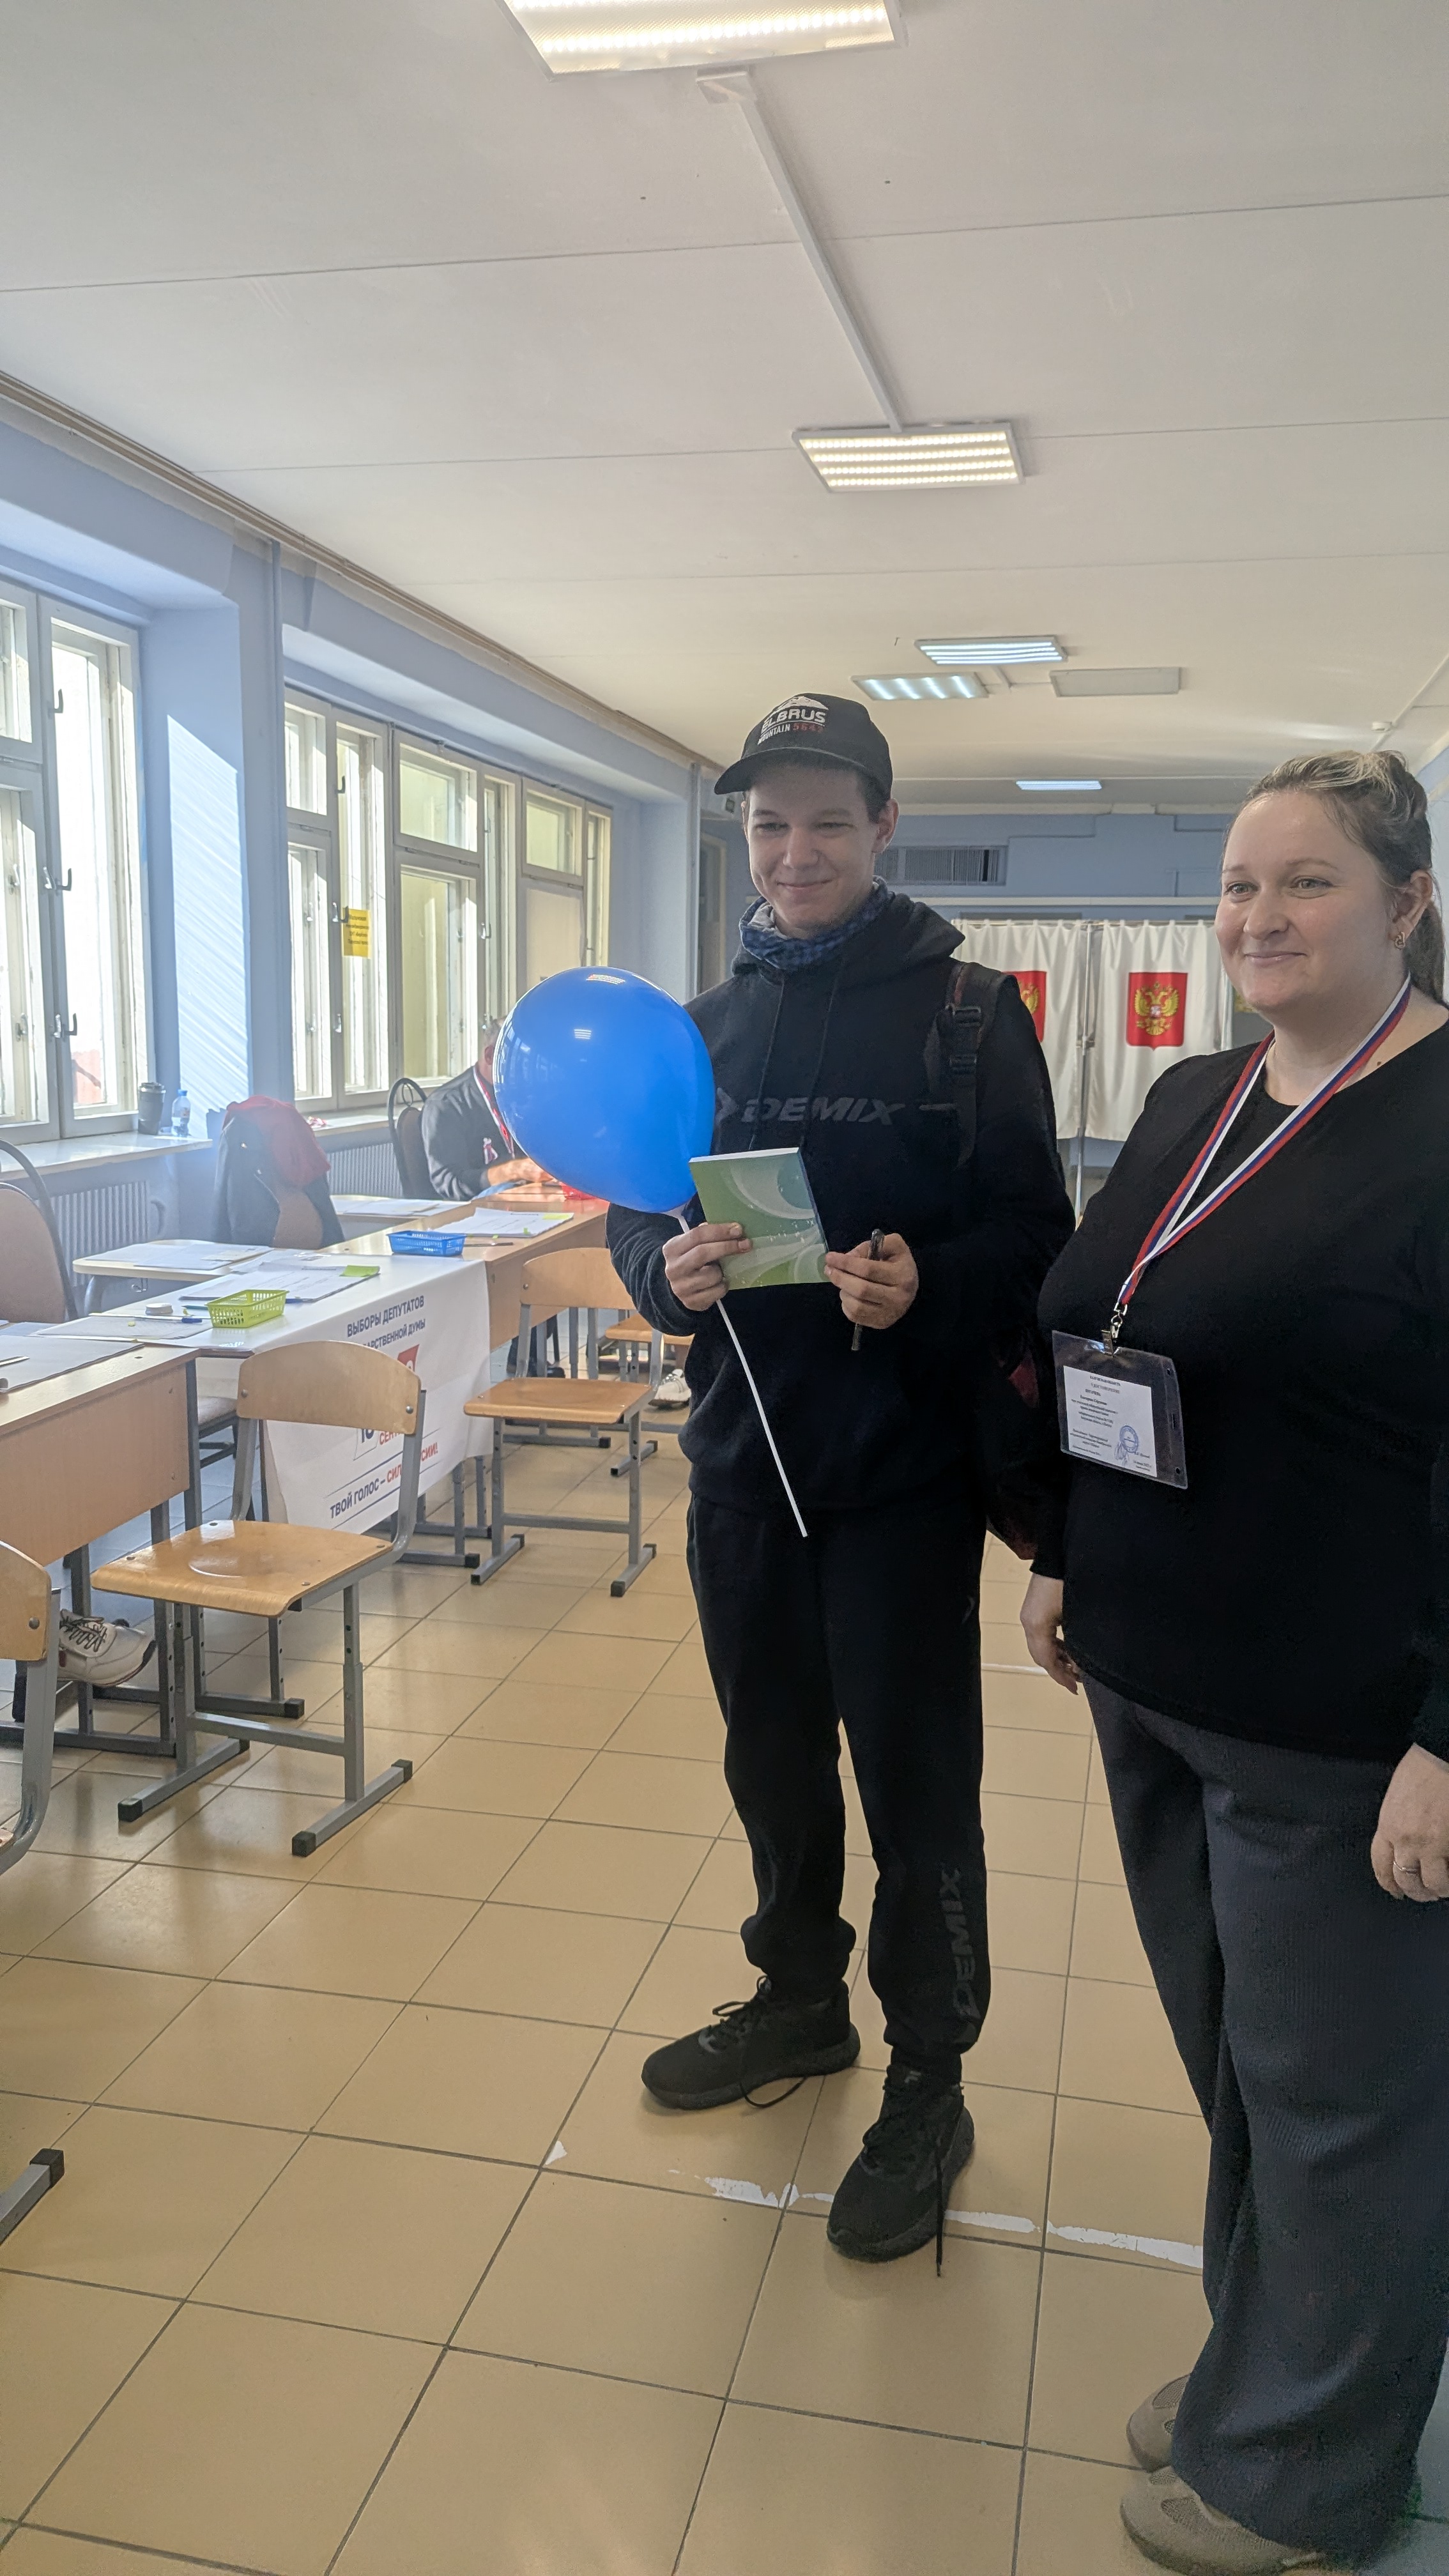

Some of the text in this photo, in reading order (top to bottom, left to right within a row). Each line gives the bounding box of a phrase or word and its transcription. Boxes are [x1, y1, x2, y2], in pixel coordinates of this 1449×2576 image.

[757, 723, 791, 746] MOUNTAIN
[761, 709, 826, 733] ELBRUS
[741, 1096, 906, 1126] DEMIX
[347, 1295, 425, 1338] ВЫБОРЫ ДЕПУТАТОВ
[408, 1318, 426, 1337] ДУМЫ
[330, 1492, 353, 1519] ТВОЙ
[354, 1478, 379, 1505] ГОЛОС
[387, 1464, 402, 1483] СИЛ
[939, 1864, 981, 2020] DEMIX
